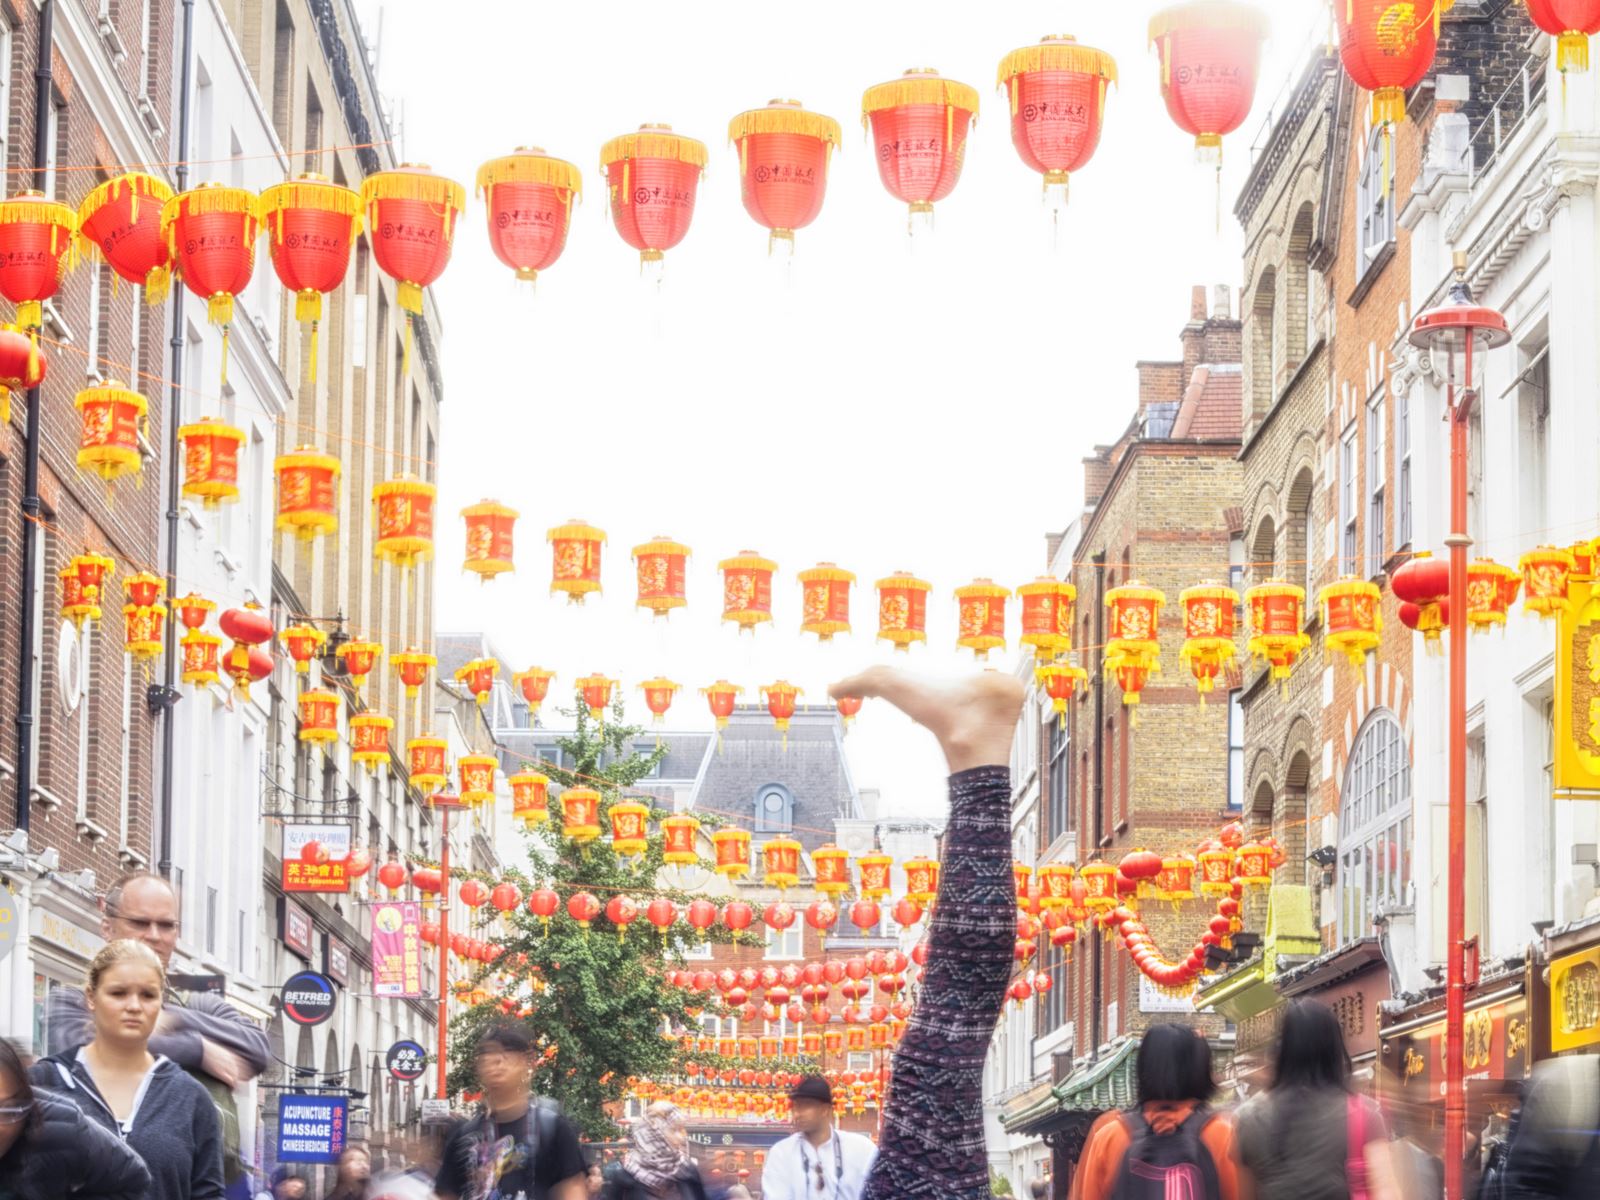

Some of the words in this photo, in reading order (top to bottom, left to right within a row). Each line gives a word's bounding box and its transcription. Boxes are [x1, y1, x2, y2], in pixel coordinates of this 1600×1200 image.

[285, 991, 332, 1001] BETFRED
[284, 1105, 331, 1120] ACUPUNCTURE
[283, 1123, 331, 1137] MASSAGE
[282, 1139, 304, 1152] CHINESE
[304, 1140, 329, 1153] MEDICINE
